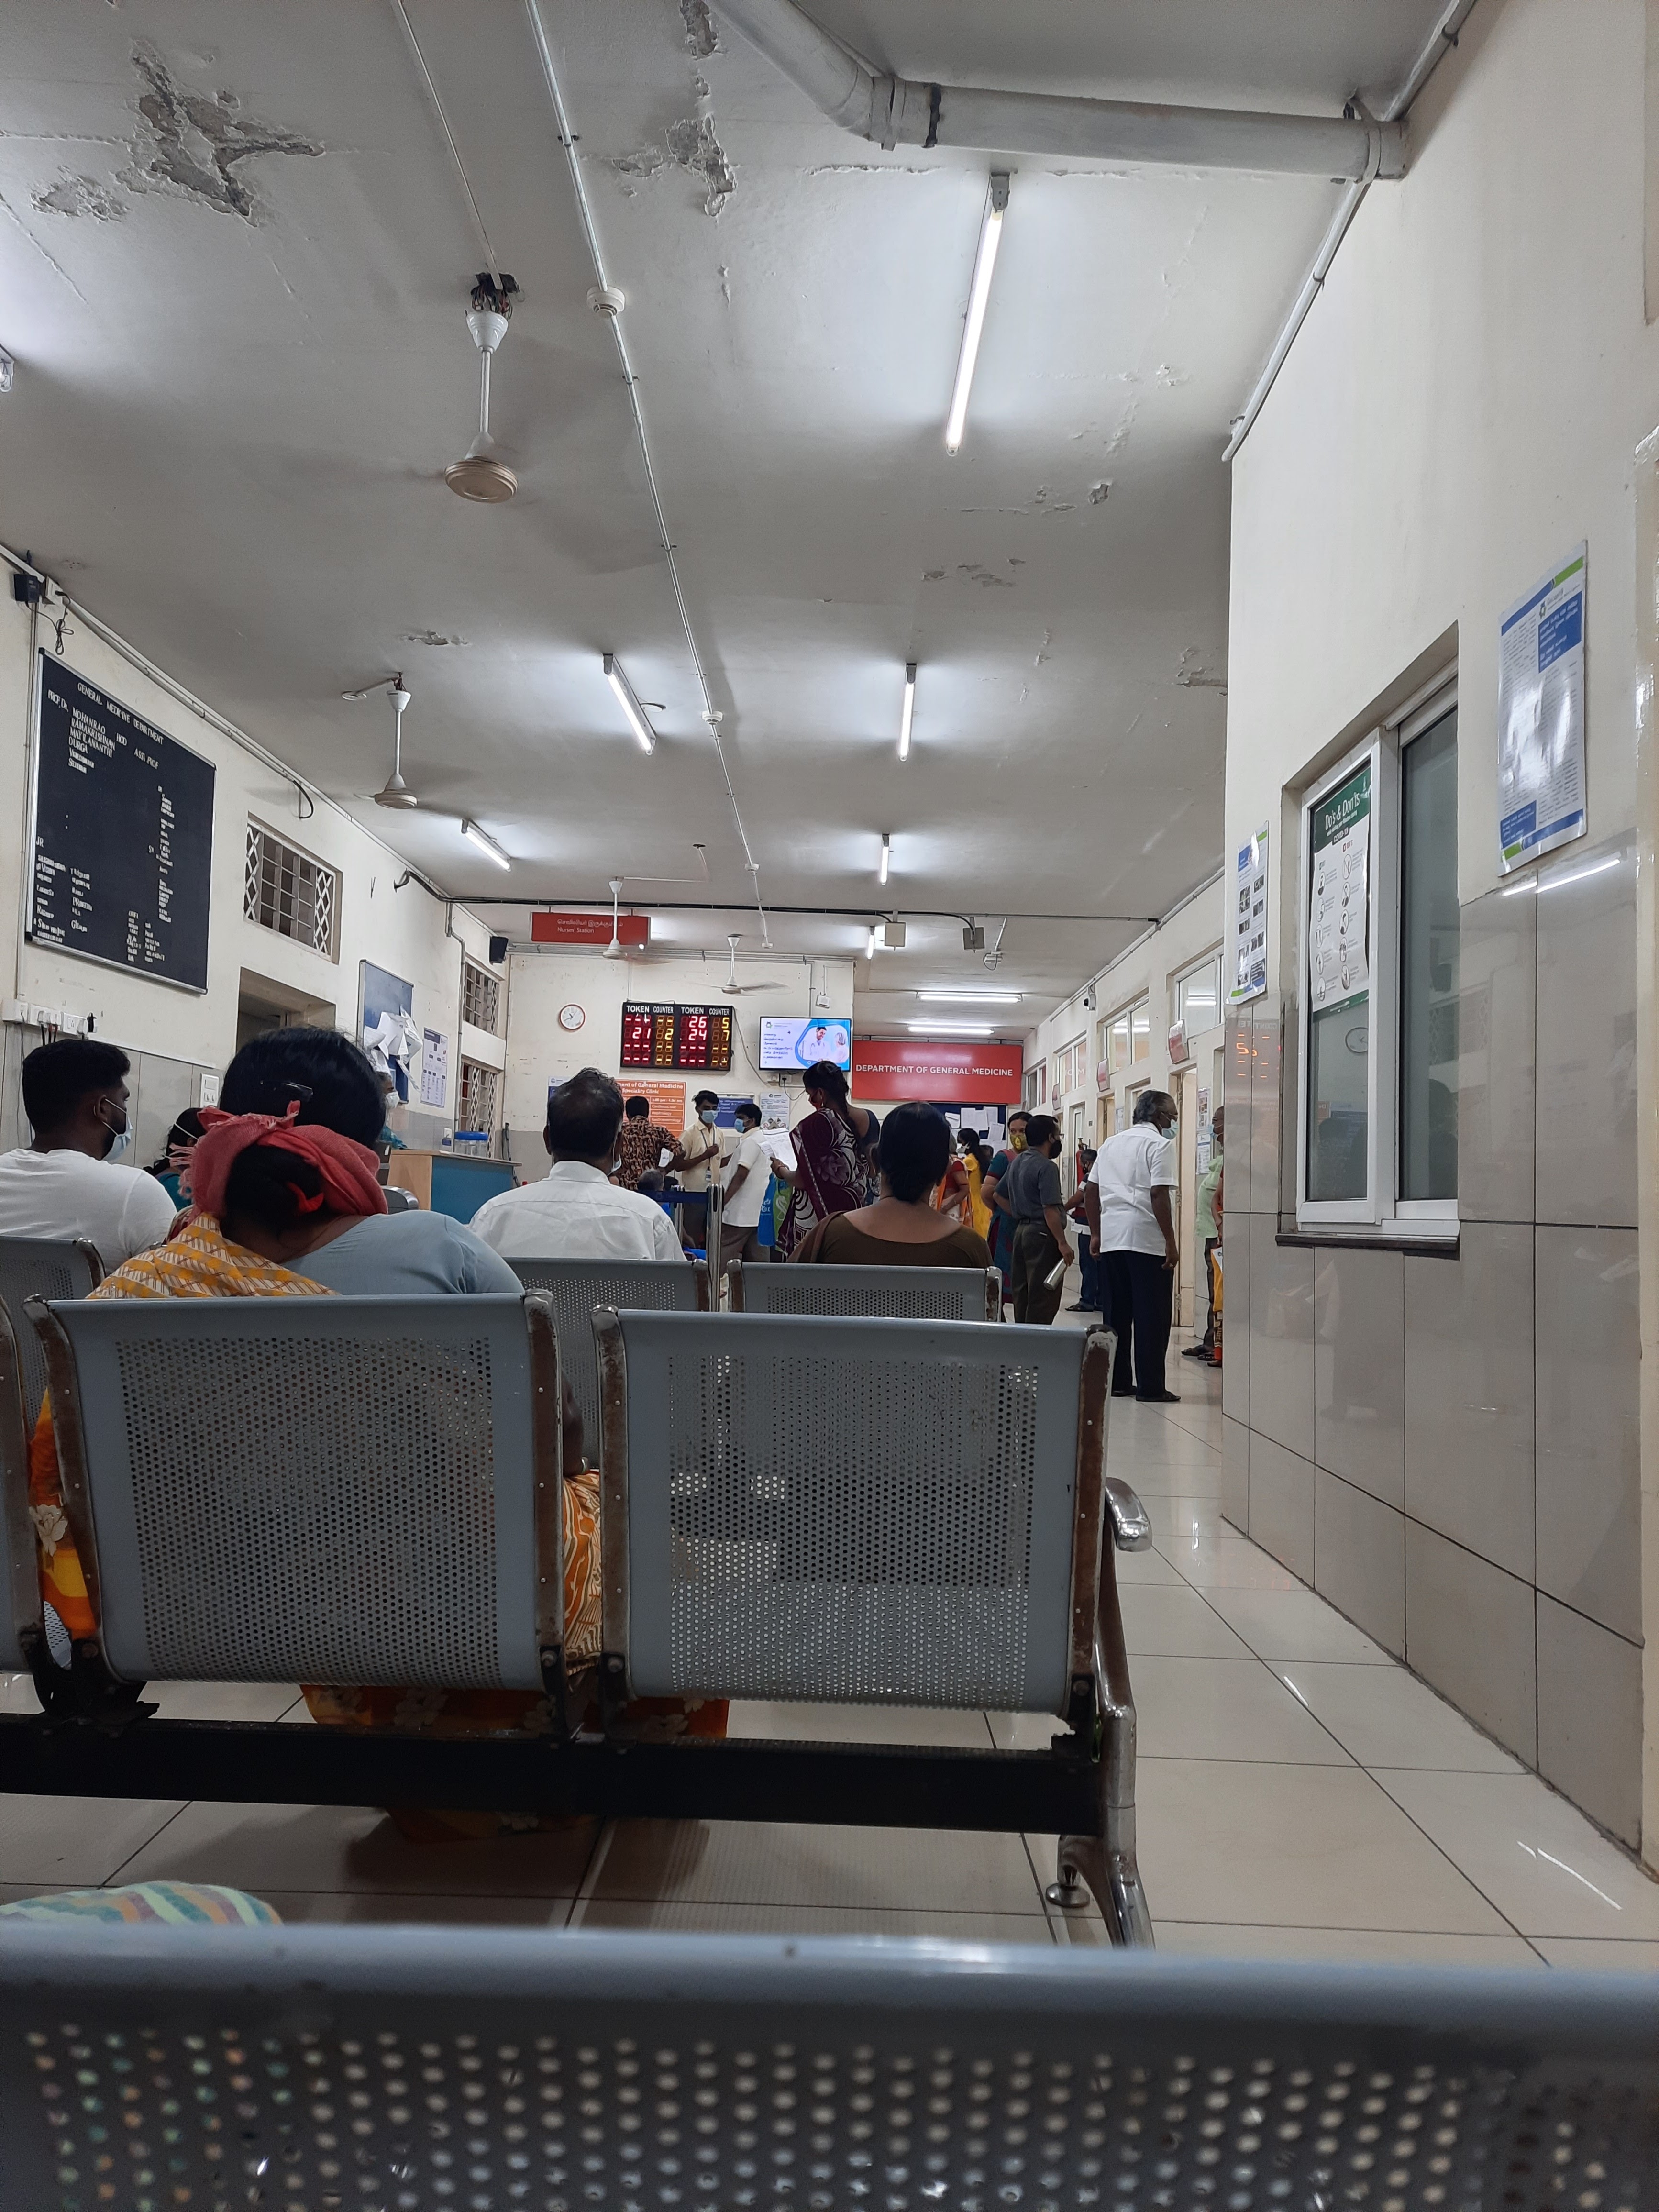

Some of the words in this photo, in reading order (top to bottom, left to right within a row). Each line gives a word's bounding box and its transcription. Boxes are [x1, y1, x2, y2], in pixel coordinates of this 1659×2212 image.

[73, 707, 105, 734] MOHANRAO
[77, 683, 102, 705] GENERAL
[106, 700, 131, 723] MEDICINE
[133, 718, 164, 745] DEPARTMENT
[71, 717, 115, 751] RAMAKRISHNAN
[68, 736, 88, 754] DURGA
[1325, 810, 1336, 830] Do's
[1337, 804, 1341, 821] &
[36, 836, 44, 848] JR
[689, 1016, 708, 1028] 26
[721, 1017, 730, 1029] 5
[632, 1027, 651, 1039] 21
[664, 1028, 674, 1040] 2
[688, 1029, 707, 1041] 24
[723, 1030, 730, 1041] 7
[856, 1065, 914, 1073] DEPARTMENT
[930, 1066, 970, 1074] GENERAL
[972, 1068, 1013, 1076] MEDICINE
